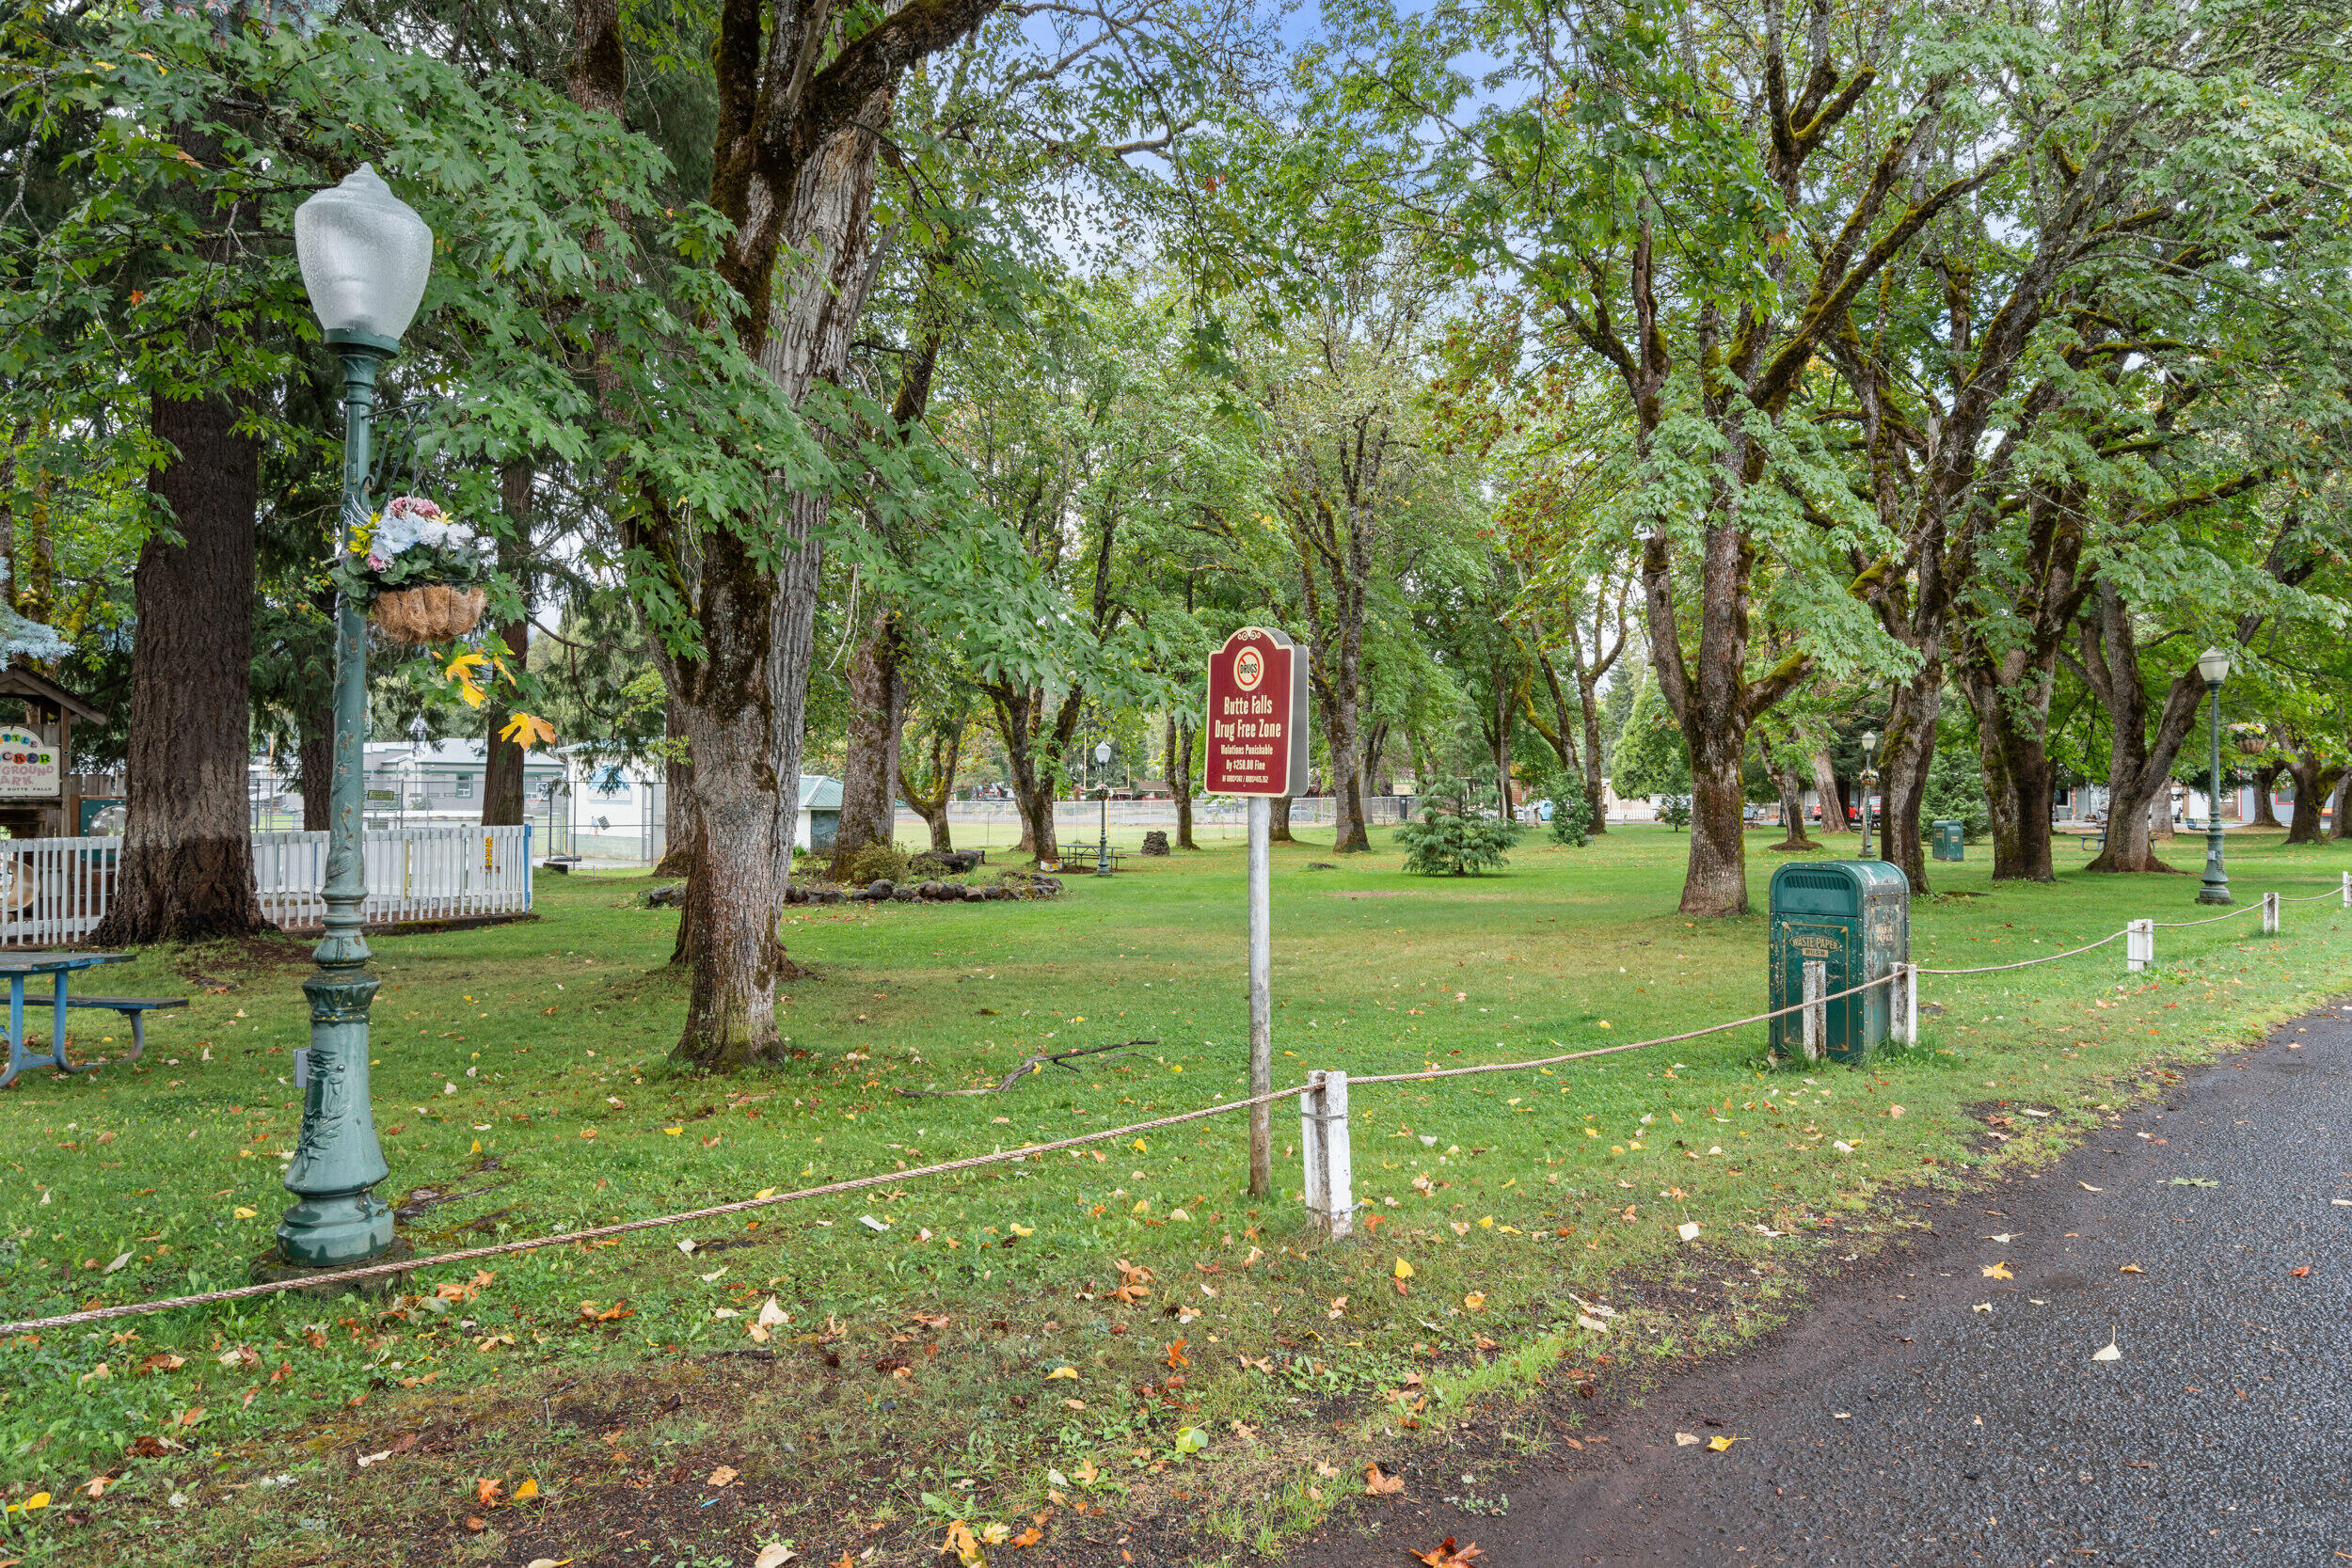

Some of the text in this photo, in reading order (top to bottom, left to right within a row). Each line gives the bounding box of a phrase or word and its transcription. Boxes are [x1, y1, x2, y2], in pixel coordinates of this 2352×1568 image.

[1240, 663, 1257, 673] DRUGS
[1224, 694, 1272, 715] Butte Falls
[1215, 718, 1281, 741] Drug Free Zone
[0, 734, 38, 749] TTLE
[1220, 744, 1273, 754] Violations Punishable
[0, 752, 51, 764] CKER
[0, 765, 55, 776] GROUND
[1226, 759, 1265, 771] By $250.00 Fine
[1792, 936, 1838, 950] WASTE PAPER
